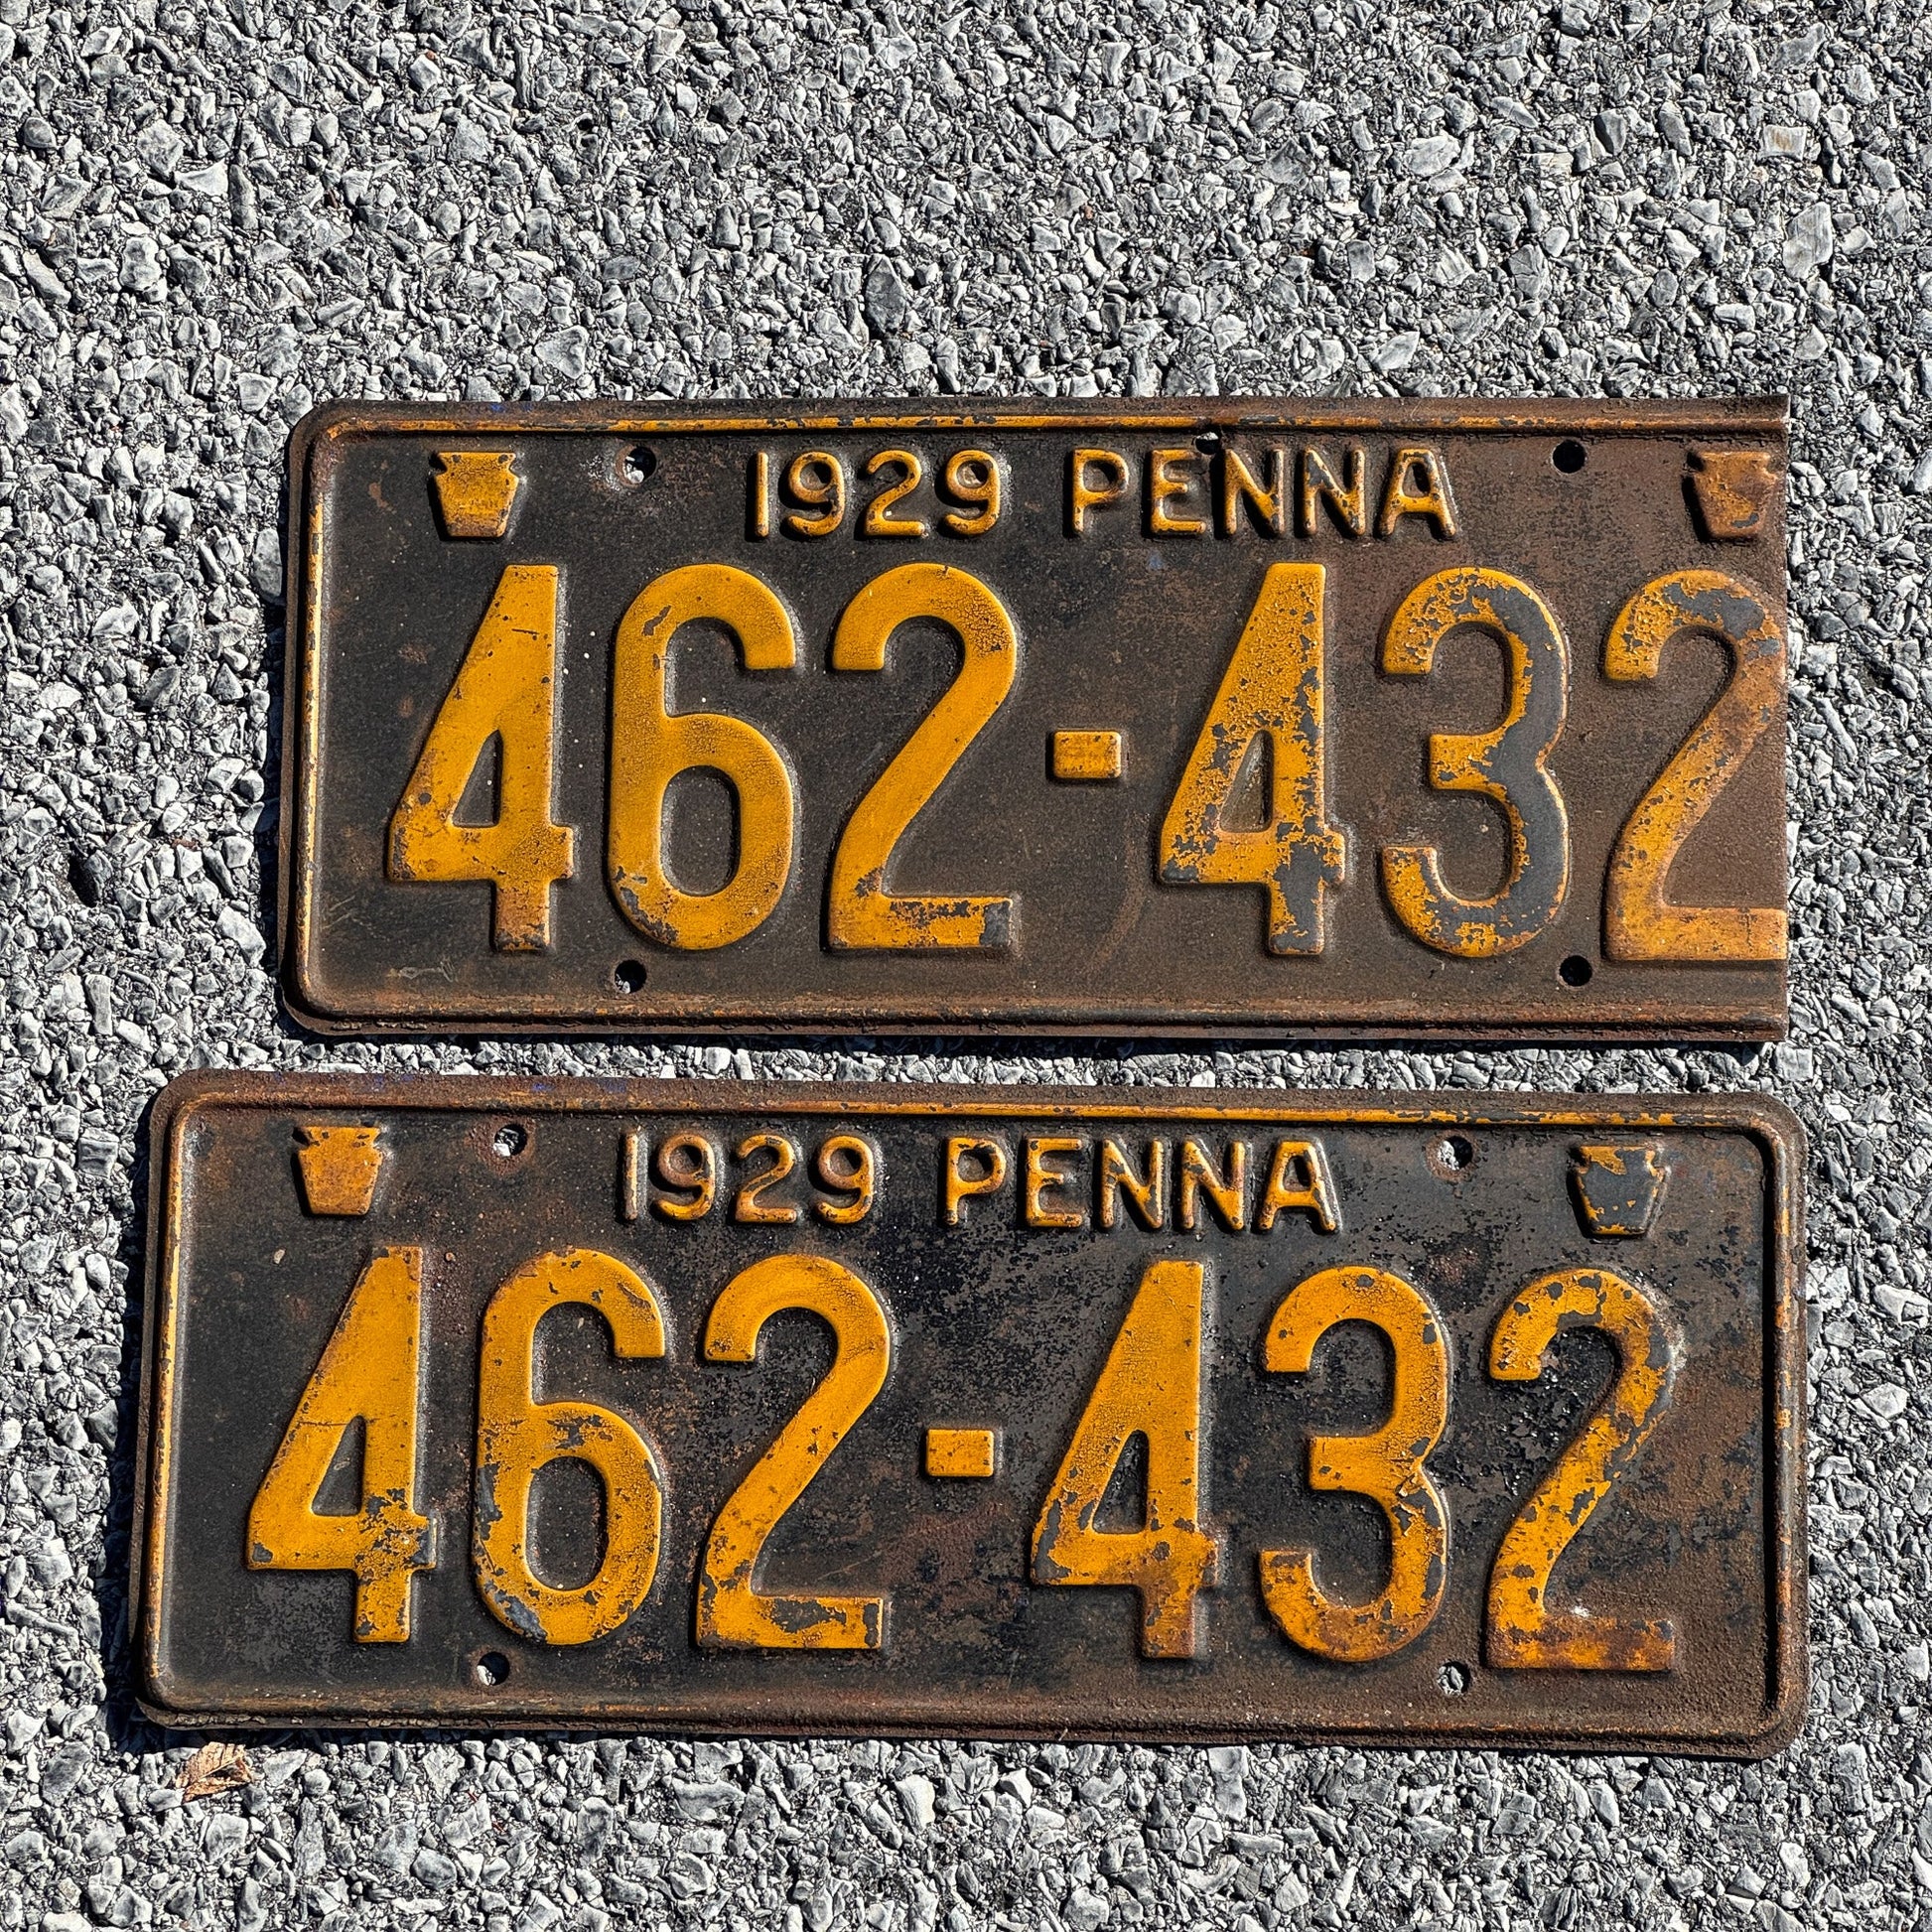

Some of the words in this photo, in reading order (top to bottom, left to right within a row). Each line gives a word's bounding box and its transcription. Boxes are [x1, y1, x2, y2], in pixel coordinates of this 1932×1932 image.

[754, 449, 1006, 537] 1929
[1070, 447, 1457, 537] PENNA
[388, 562, 1788, 960] 462-432
[622, 1132, 877, 1222] 1929
[944, 1136, 1338, 1231] PENNA
[248, 1244, 1678, 1672] 462-432
